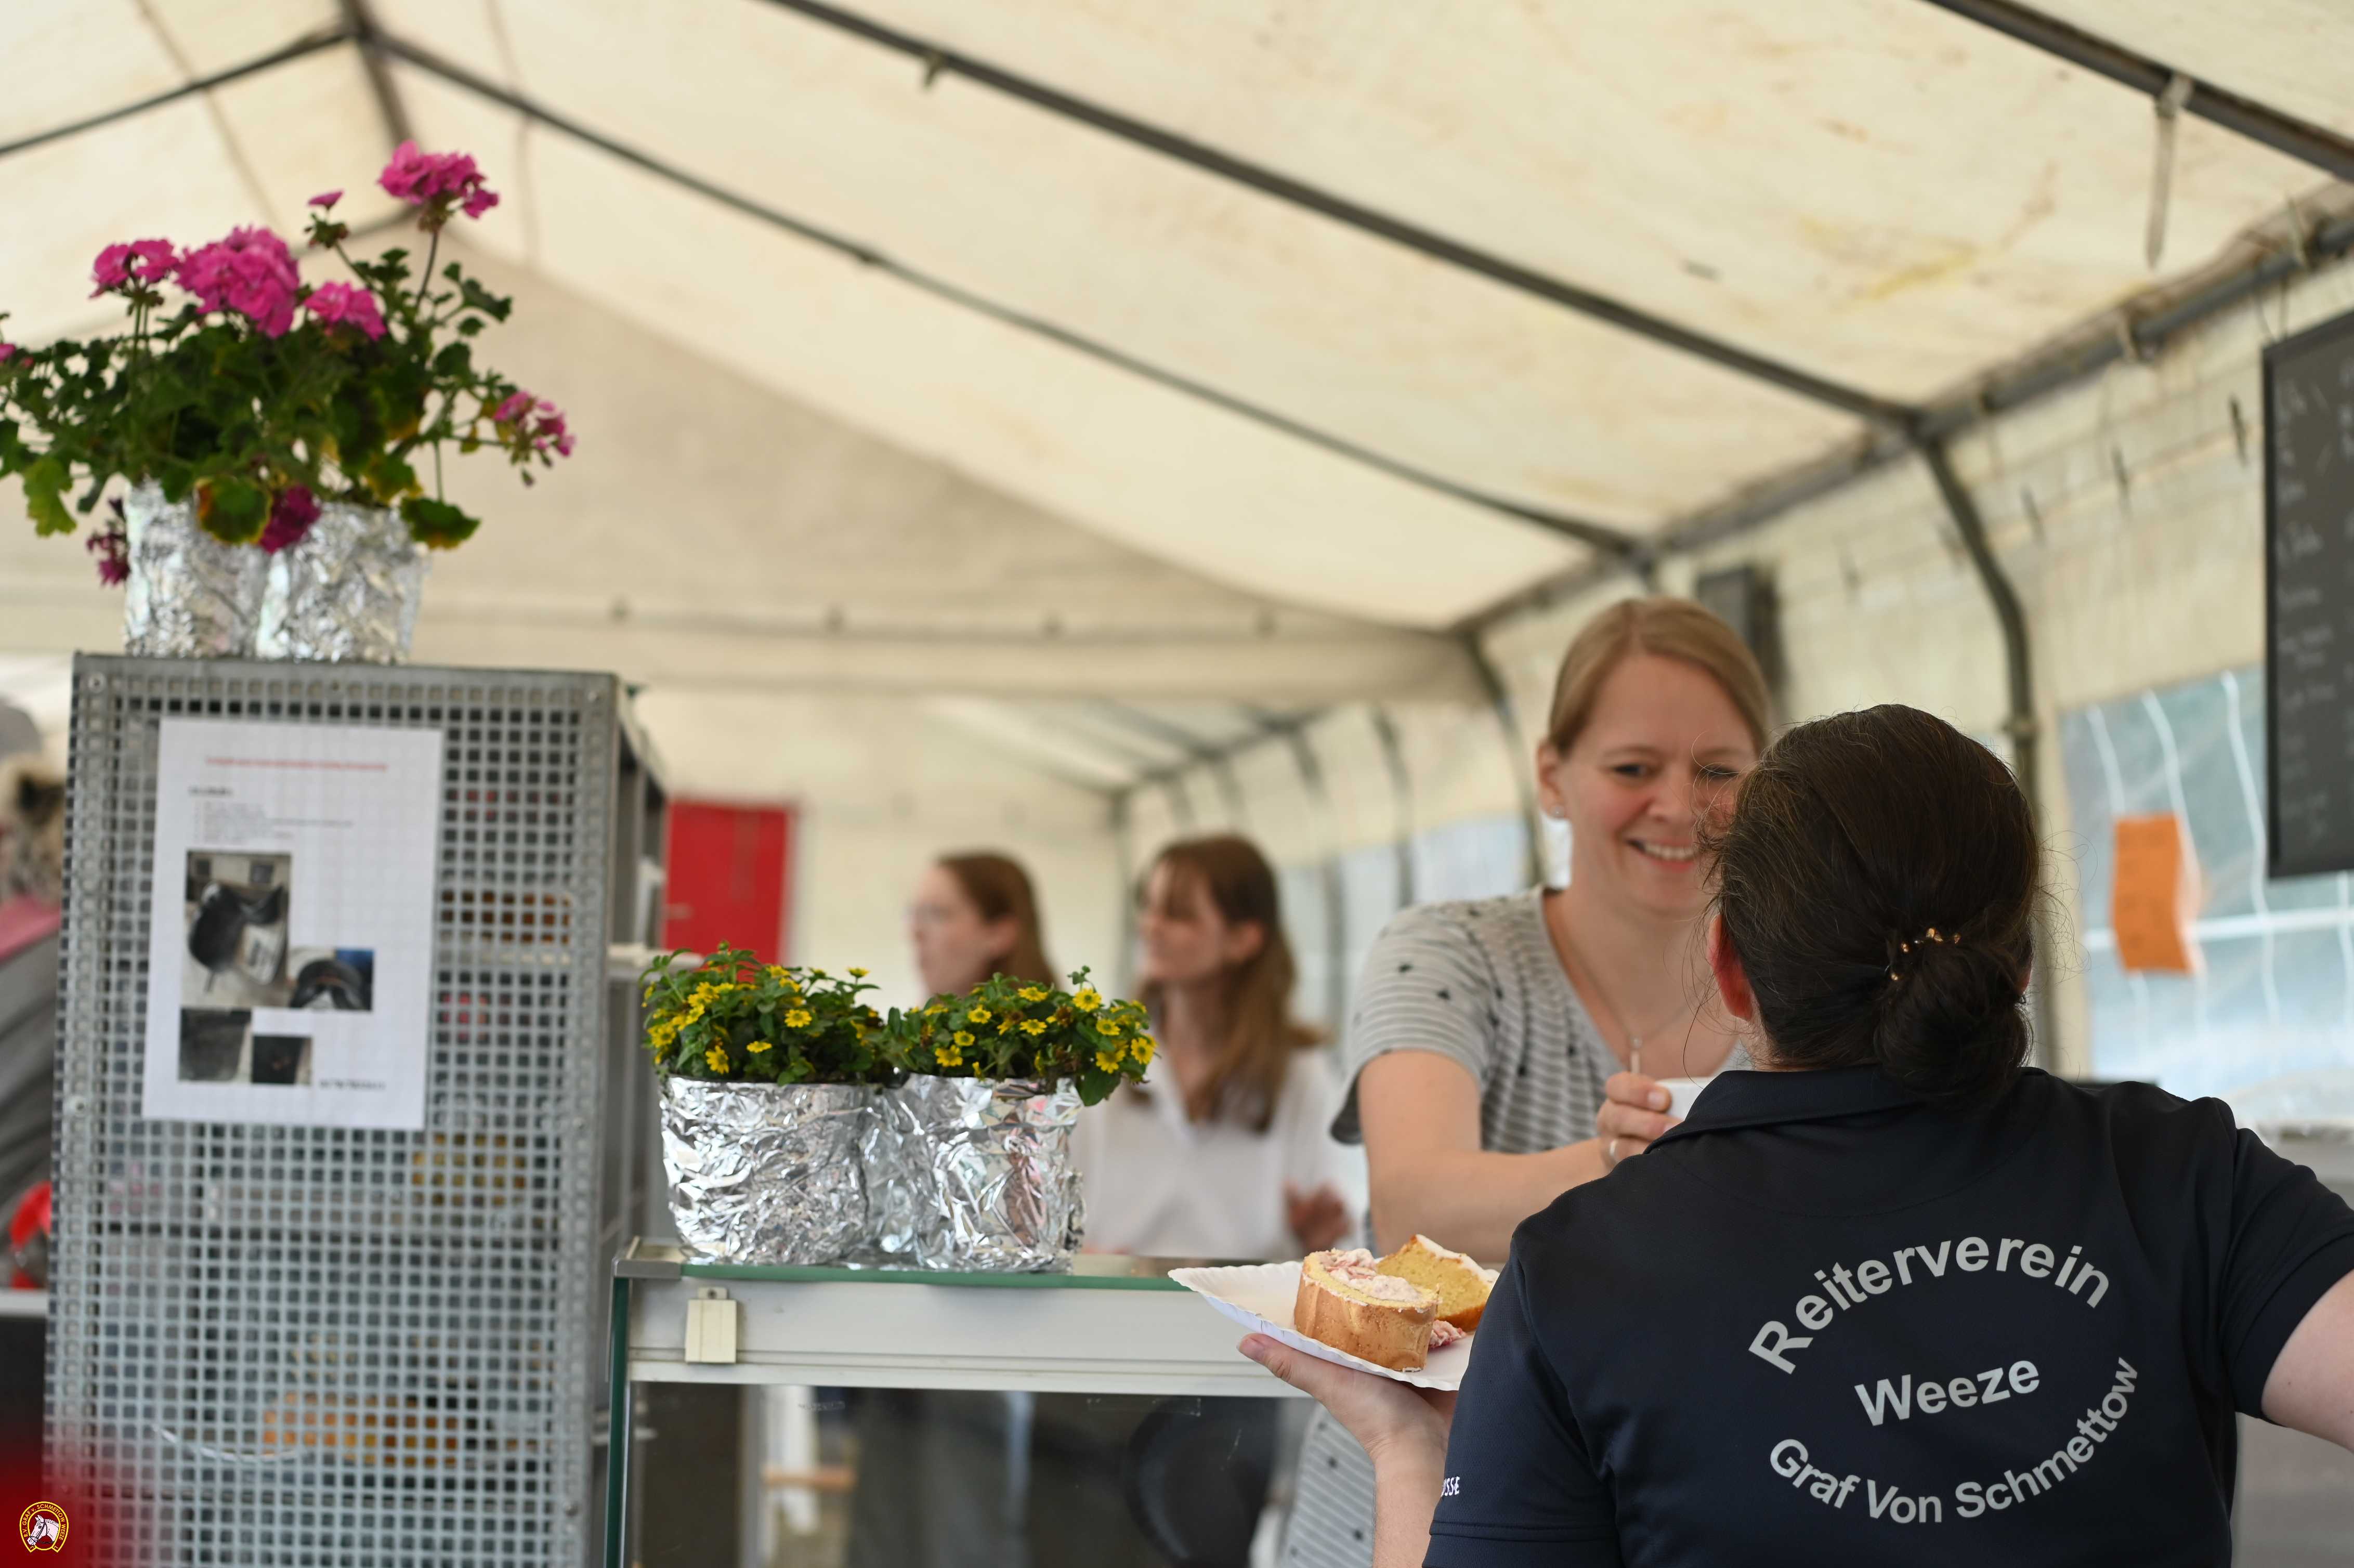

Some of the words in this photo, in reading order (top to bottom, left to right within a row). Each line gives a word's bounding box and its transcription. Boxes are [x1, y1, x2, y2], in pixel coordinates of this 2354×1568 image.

[1748, 1236, 2109, 1375] Reiterverein
[1770, 1439, 1861, 1509] Graf
[1867, 1479, 1942, 1524] Von
[1955, 1357, 2138, 1518] Schmettow
[1854, 1360, 2040, 1426] Weeze
